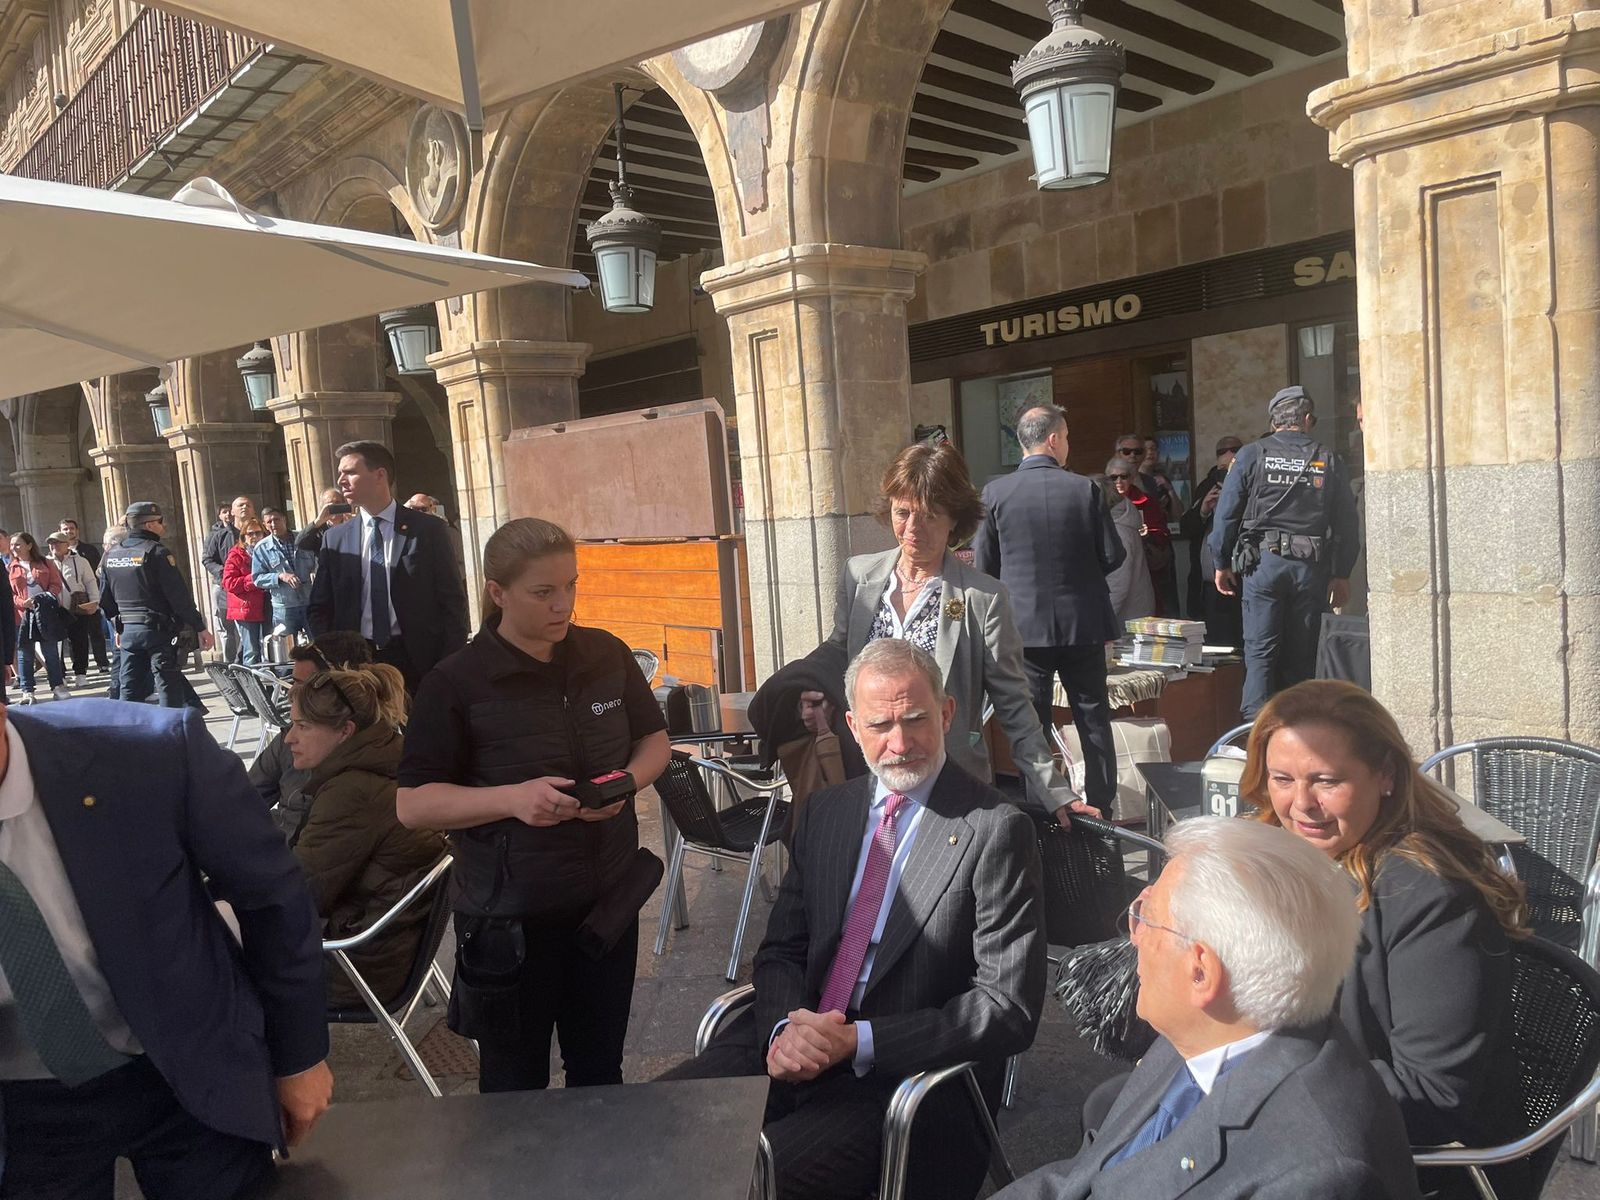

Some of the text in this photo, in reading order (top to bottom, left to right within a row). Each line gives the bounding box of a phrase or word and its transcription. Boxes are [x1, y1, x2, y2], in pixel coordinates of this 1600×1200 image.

[979, 293, 1143, 346] TURISMO
[1264, 456, 1310, 466] POLICI
[1266, 473, 1311, 487] U.I.P.
[603, 698, 622, 710] nero
[1211, 793, 1237, 818] 91
